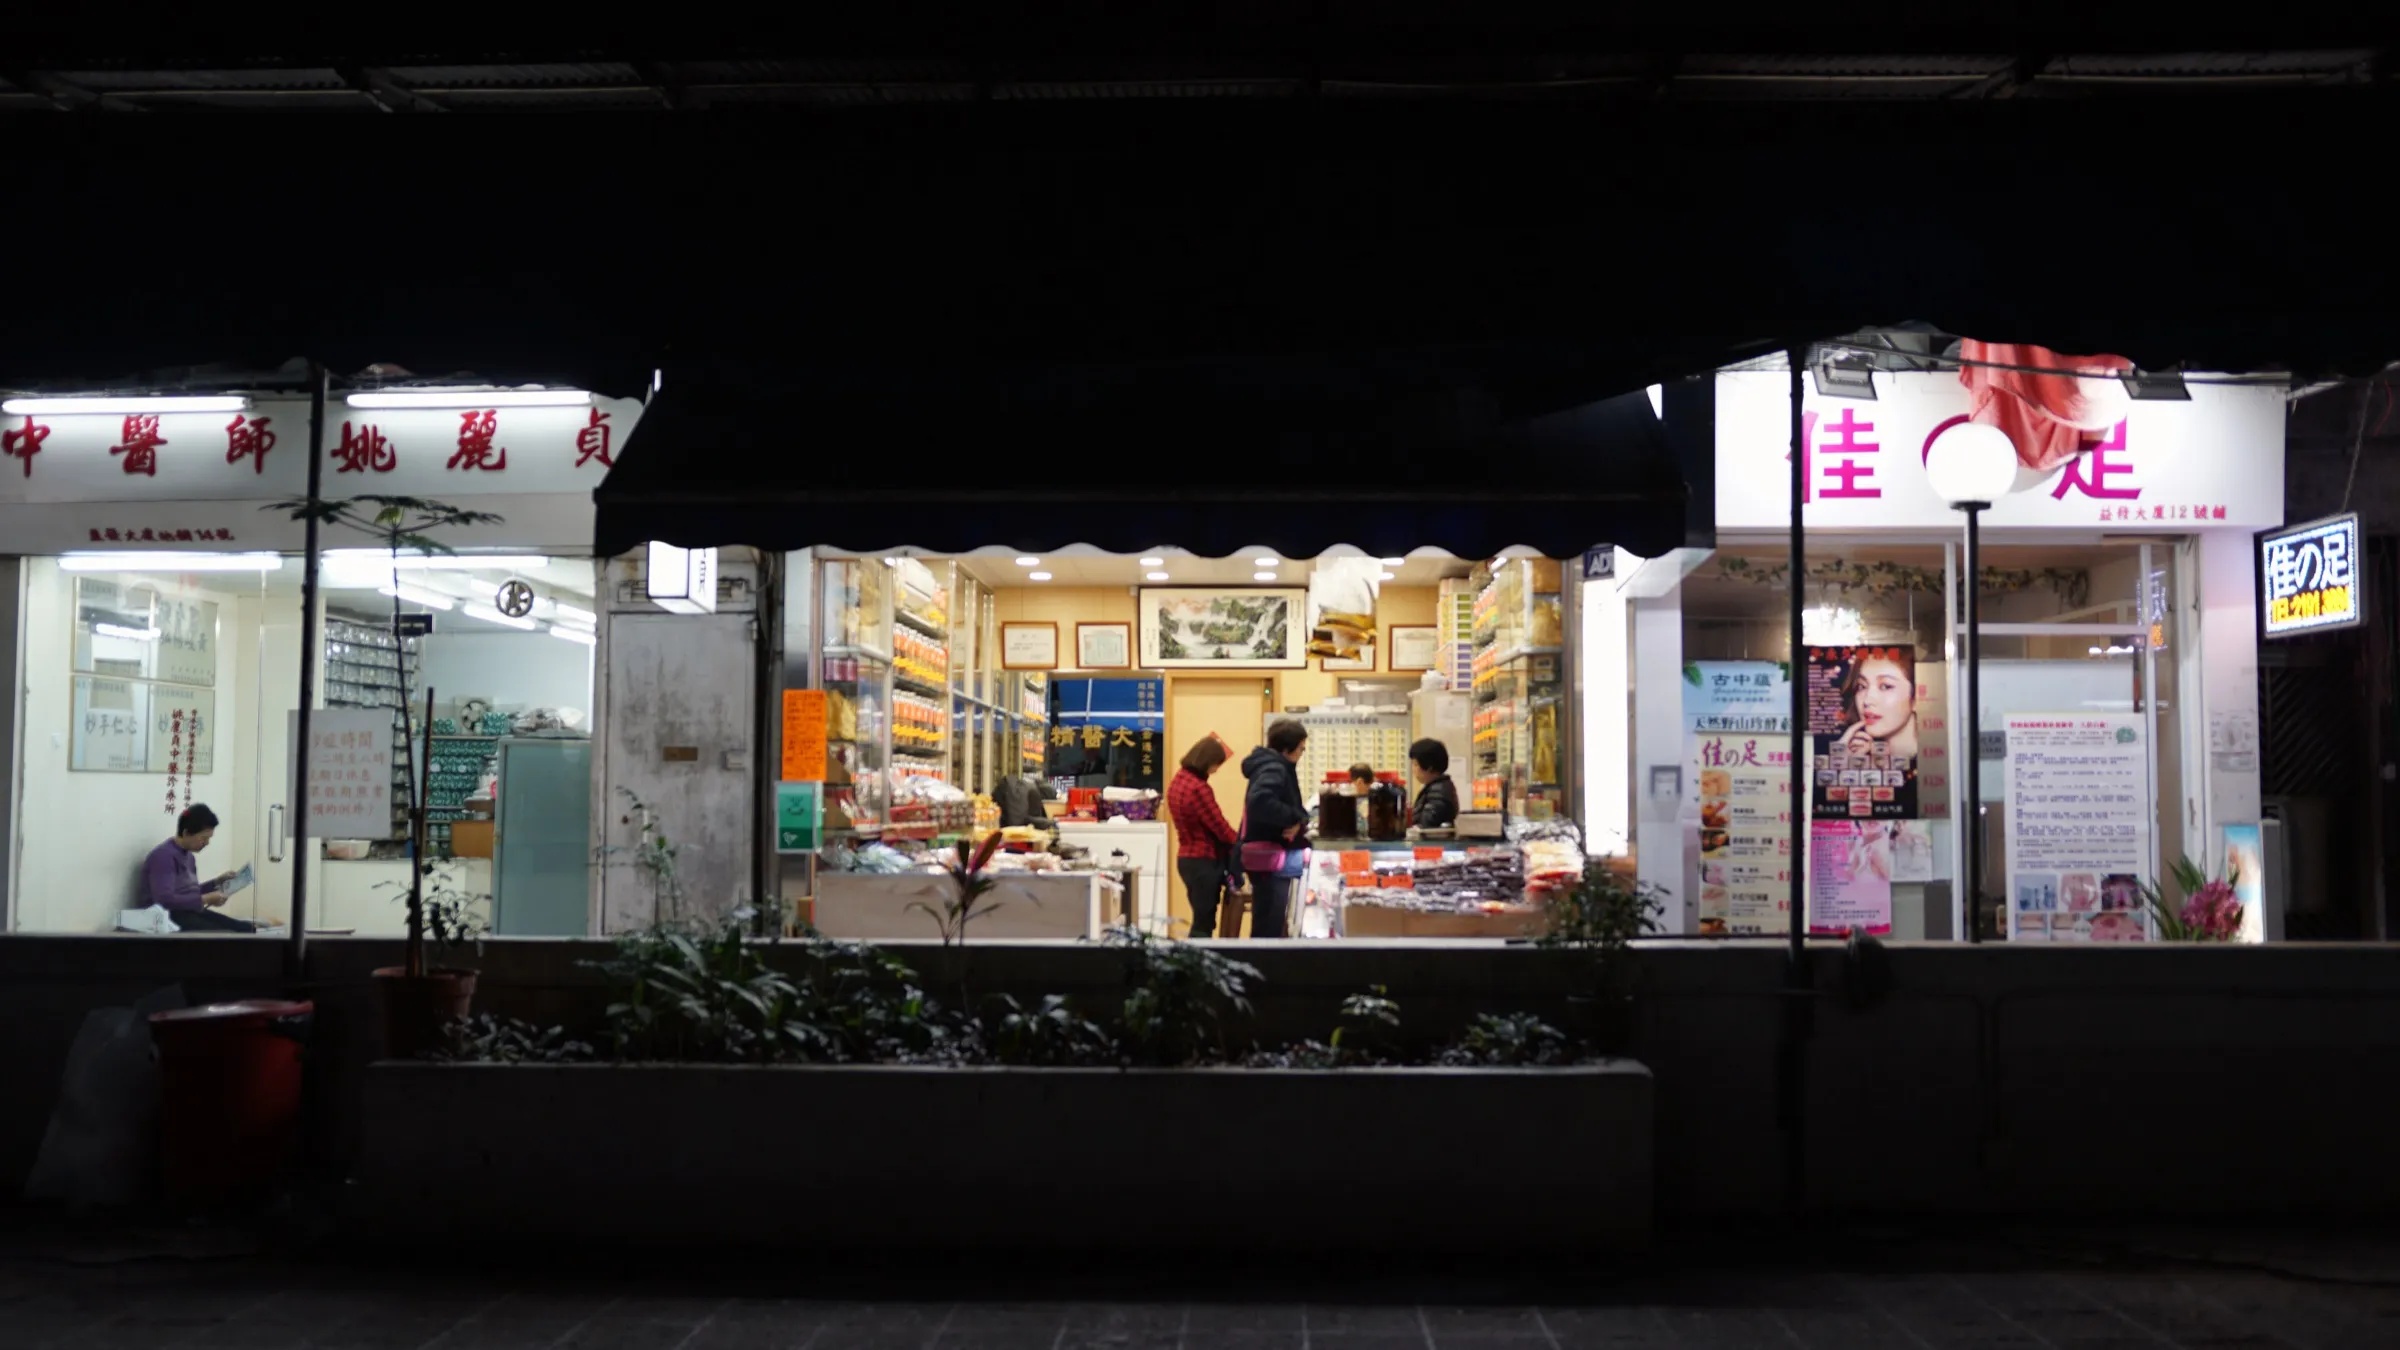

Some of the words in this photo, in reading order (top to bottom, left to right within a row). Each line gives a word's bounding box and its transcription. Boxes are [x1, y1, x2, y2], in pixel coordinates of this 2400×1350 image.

[2, 414, 277, 478] 中醫師
[331, 408, 614, 474] 姚麗貞
[2270, 532, 2350, 600] 佳の足
[1702, 736, 1763, 768] 佳の足
